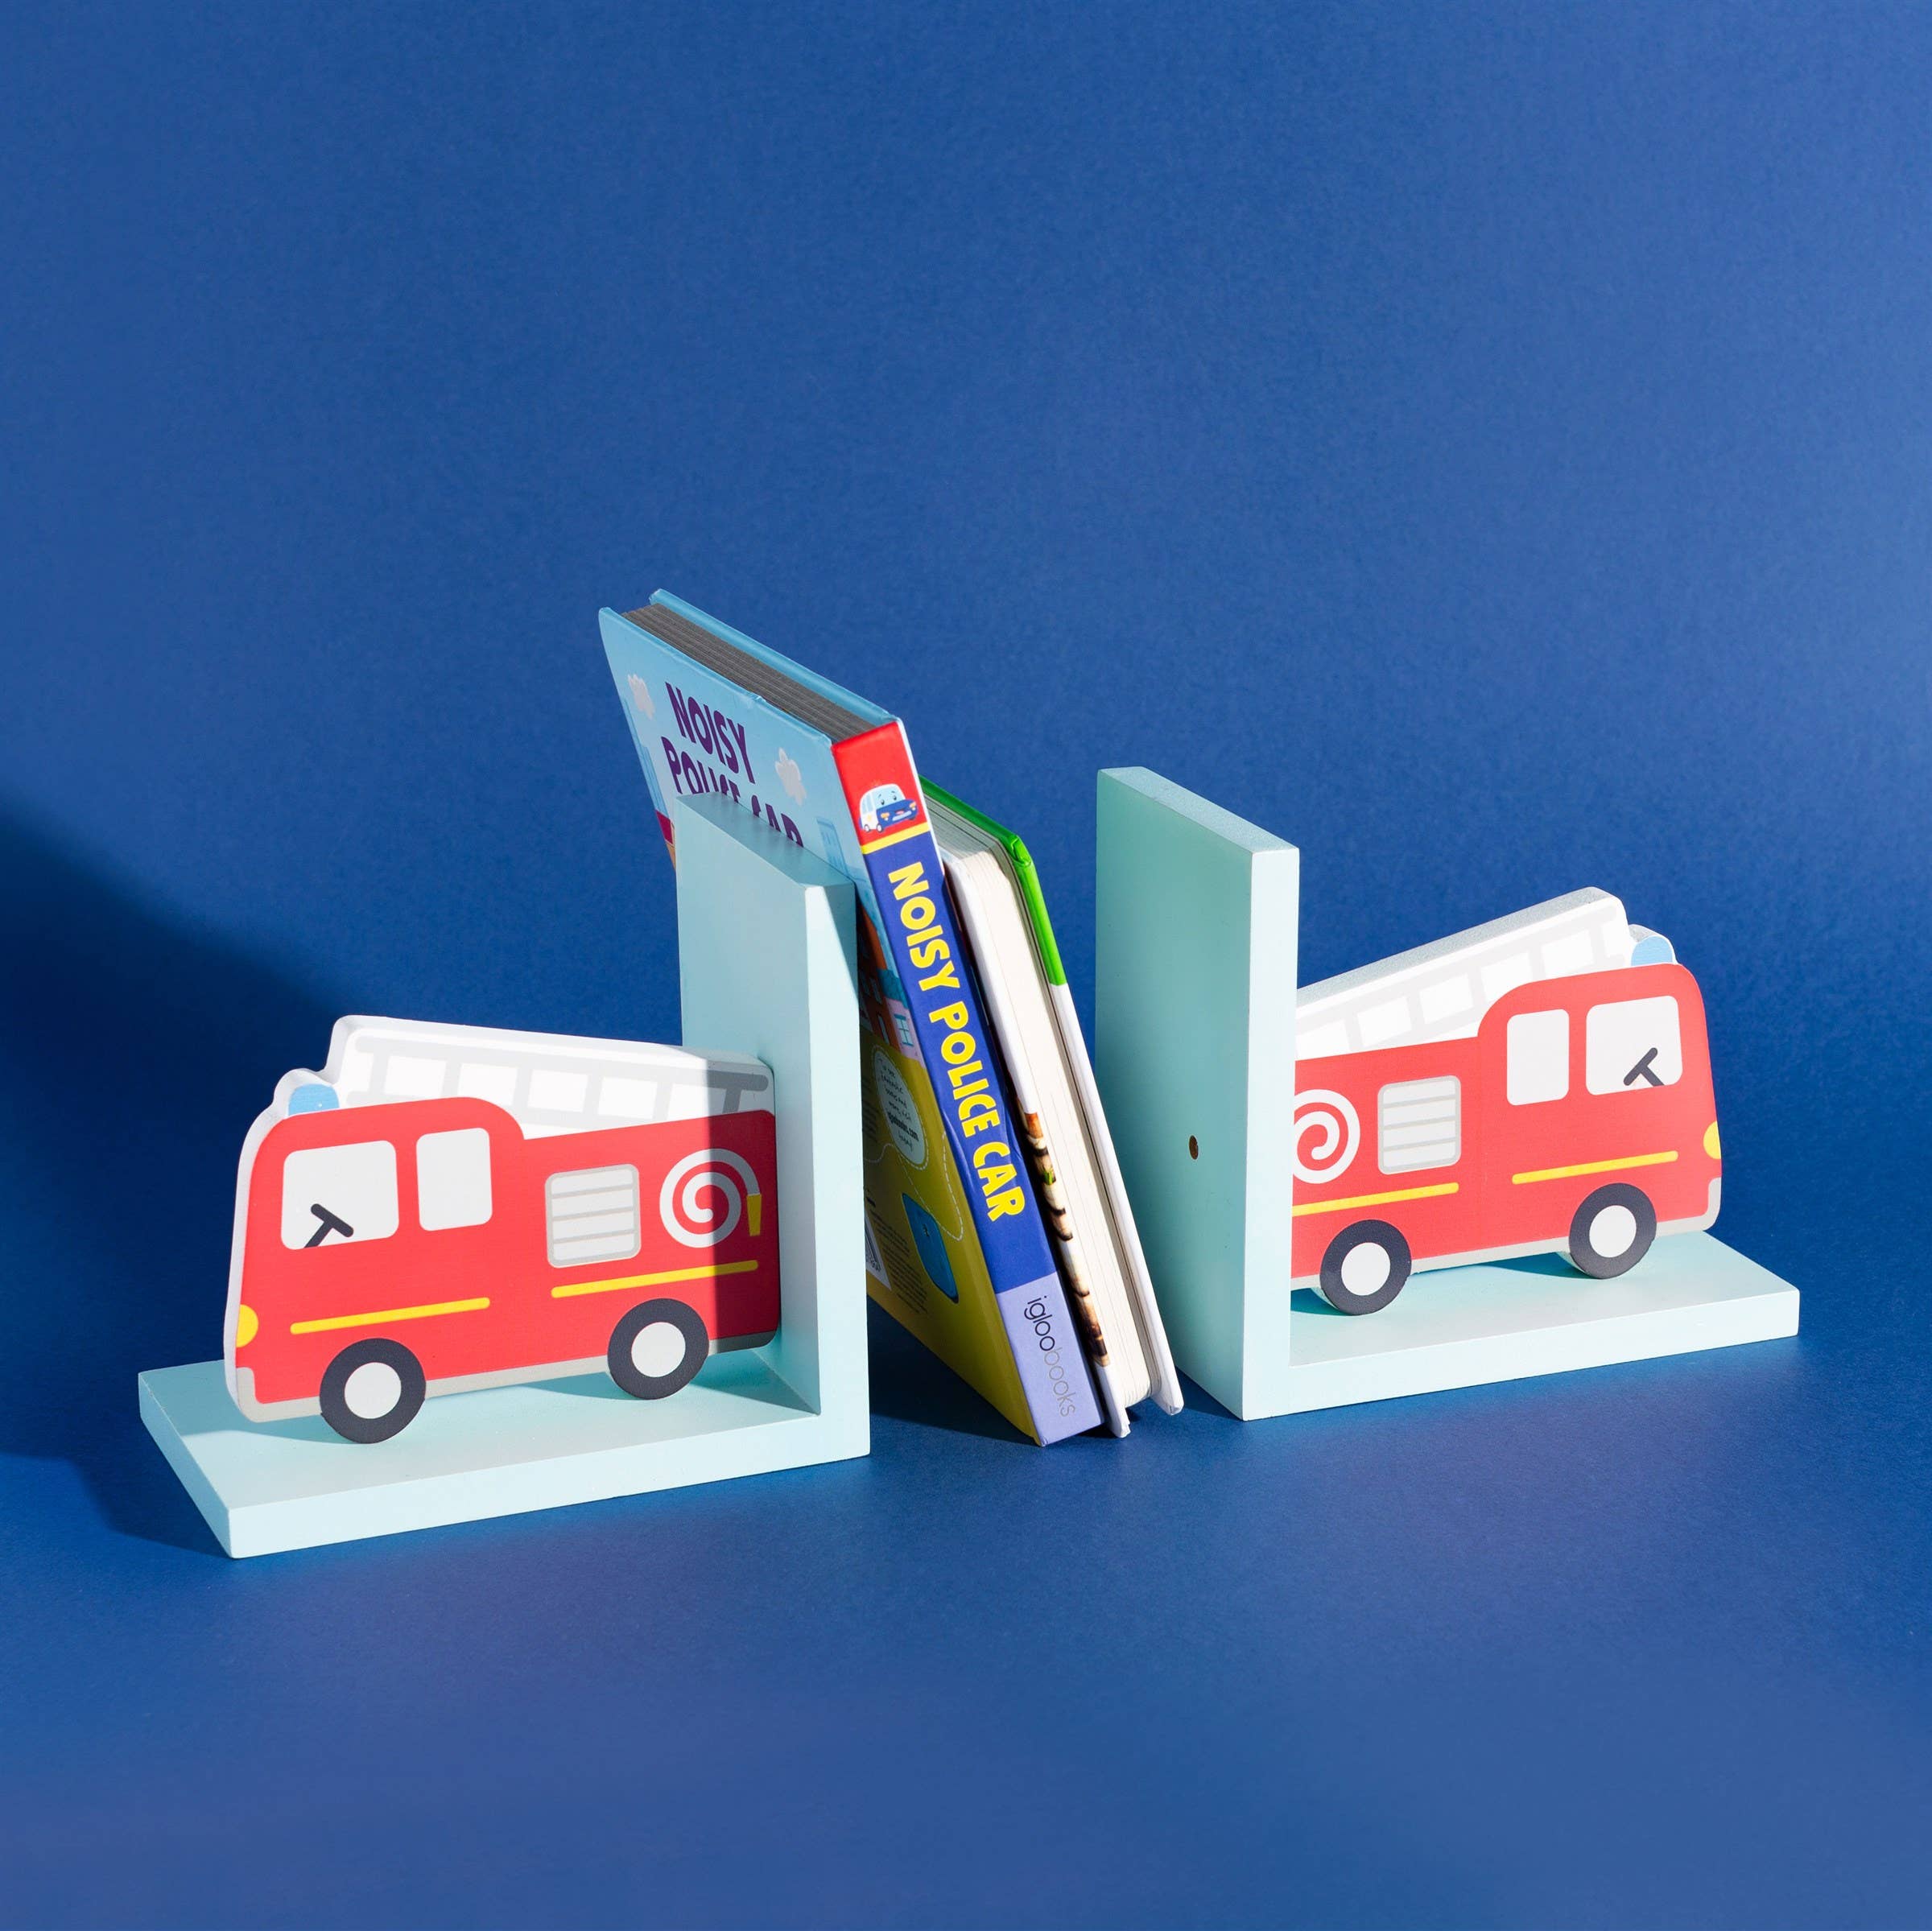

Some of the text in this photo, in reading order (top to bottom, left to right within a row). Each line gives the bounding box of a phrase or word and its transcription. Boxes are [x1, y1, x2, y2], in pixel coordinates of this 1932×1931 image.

[665, 682, 755, 784] NOISY
[888, 862, 960, 991] NOISY
[929, 1001, 1001, 1138] POLICE
[973, 1141, 1026, 1222] CAR
